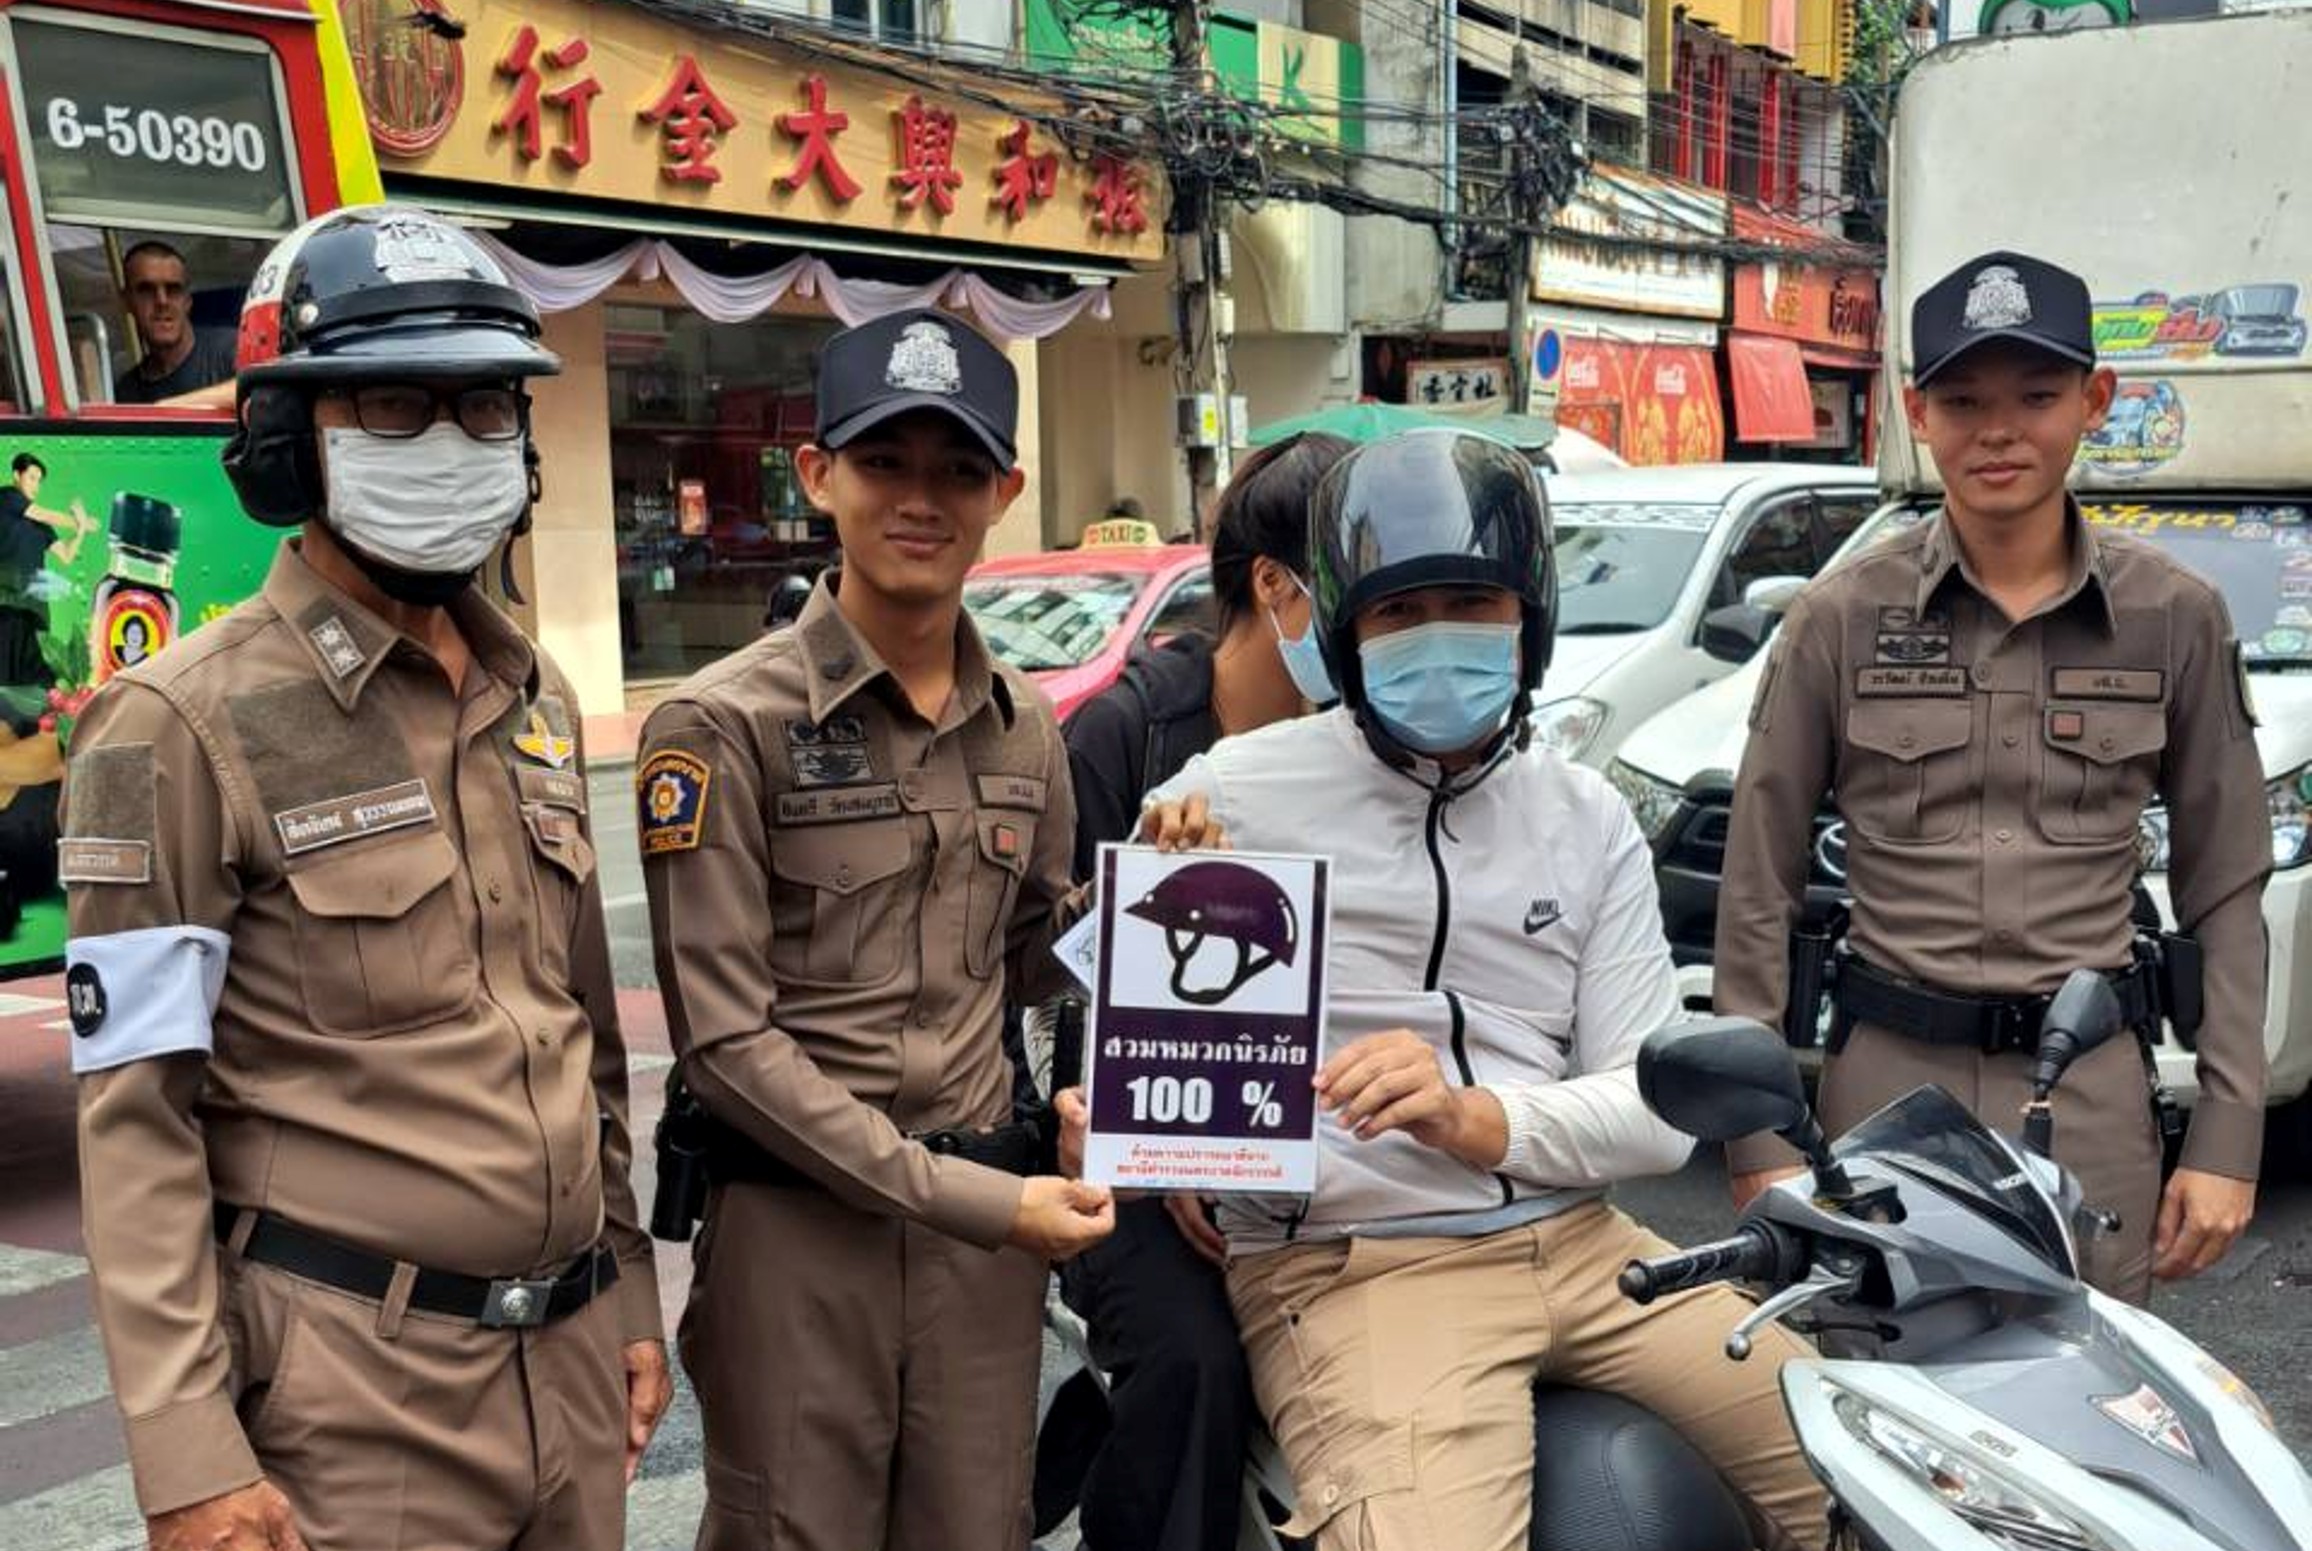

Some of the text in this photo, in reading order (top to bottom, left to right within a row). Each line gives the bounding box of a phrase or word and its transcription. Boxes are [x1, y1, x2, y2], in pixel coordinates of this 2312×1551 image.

[48, 98, 265, 171] 6-50390
[1101, 525, 1131, 543] TAXI
[1104, 1032, 1308, 1065] สวมหมวกนิรภัย
[1126, 1075, 1283, 1127] 100 %
